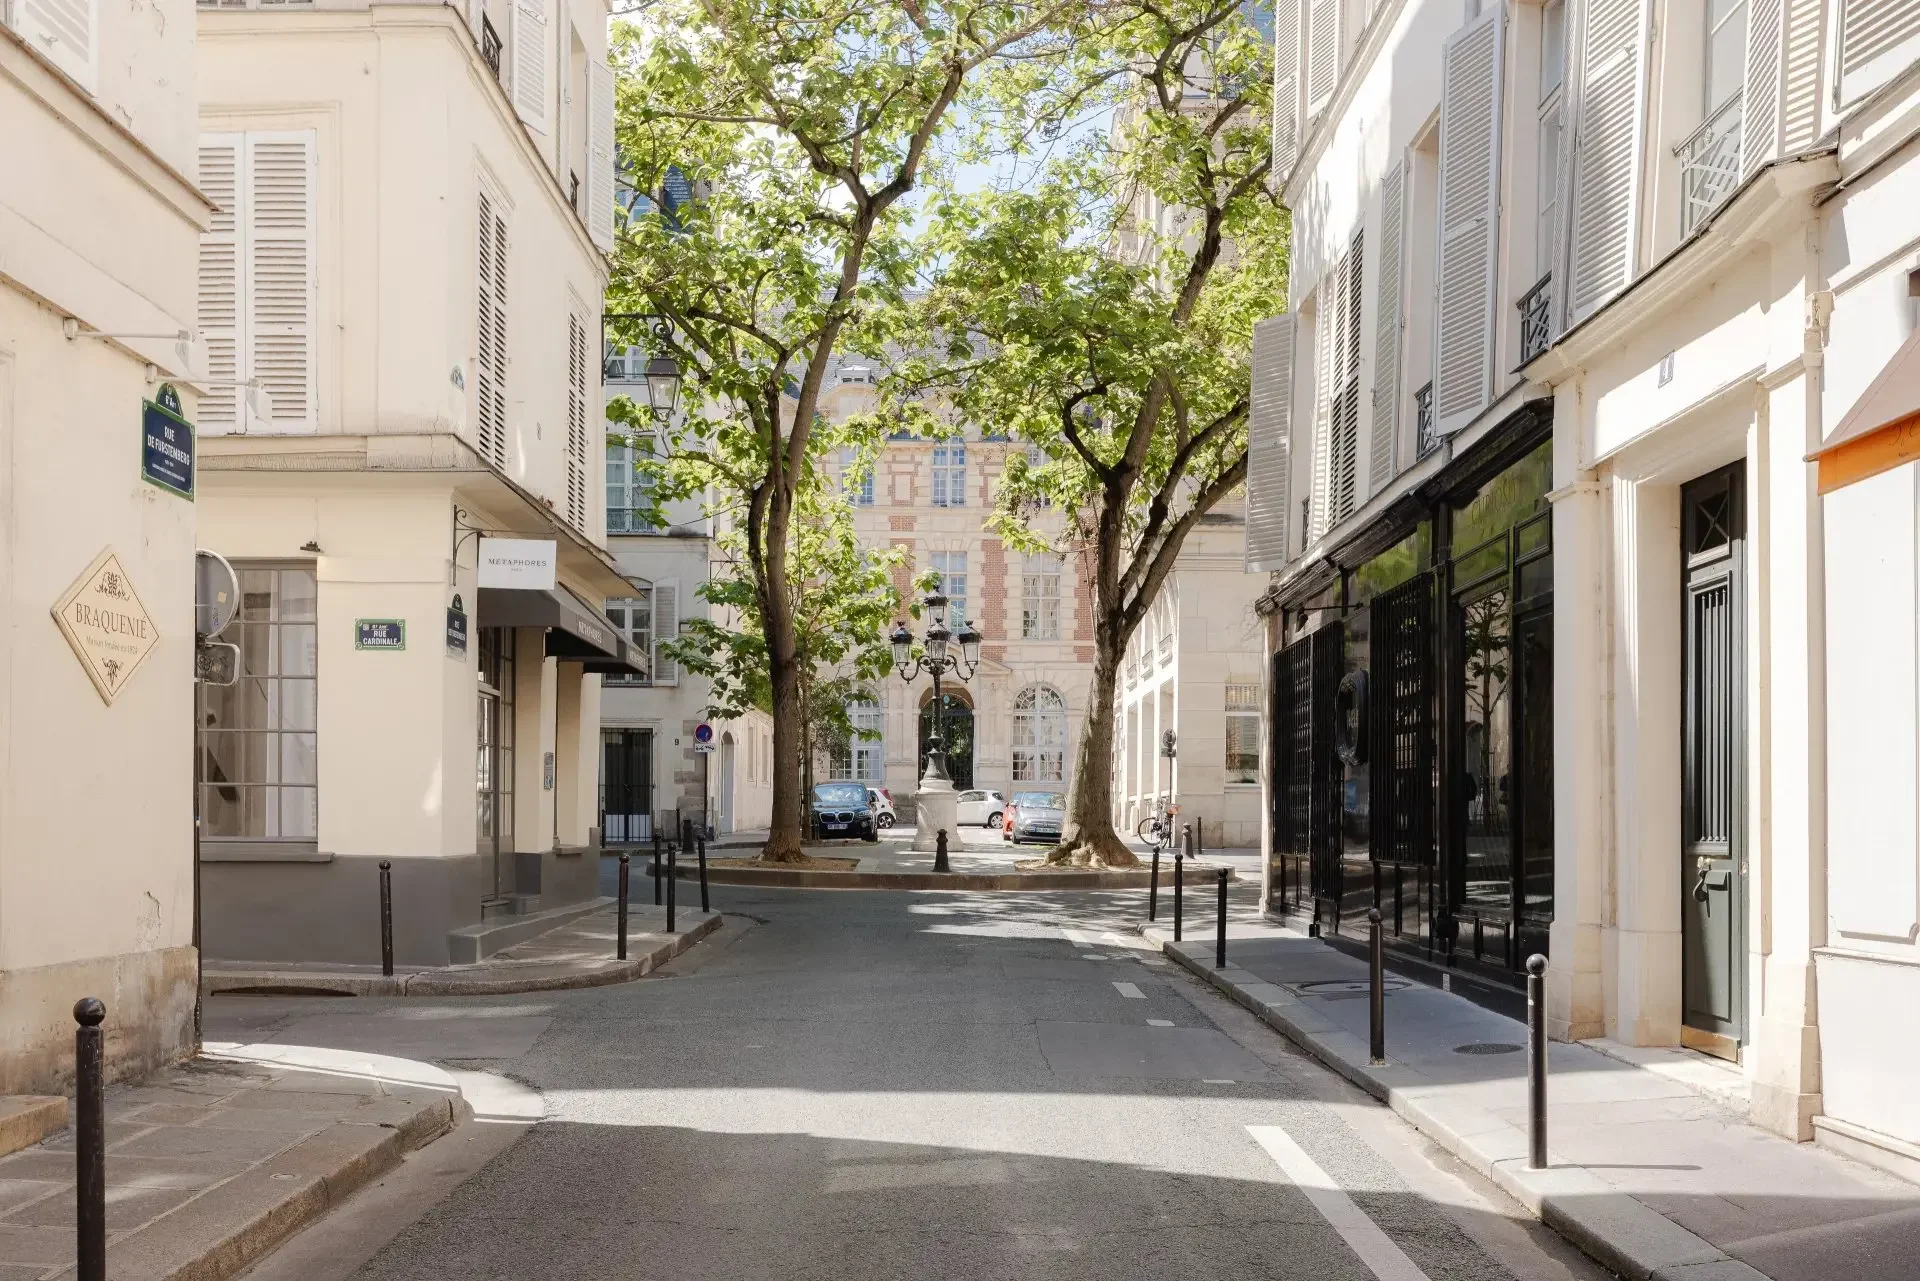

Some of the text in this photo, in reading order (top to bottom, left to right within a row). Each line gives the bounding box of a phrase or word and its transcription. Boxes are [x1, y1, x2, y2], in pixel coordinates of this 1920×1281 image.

[147, 434, 155, 448] DE
[164, 425, 175, 442] RUE
[76, 603, 147, 639] BRAQUENIÉ
[363, 637, 398, 645] CARDINALE
